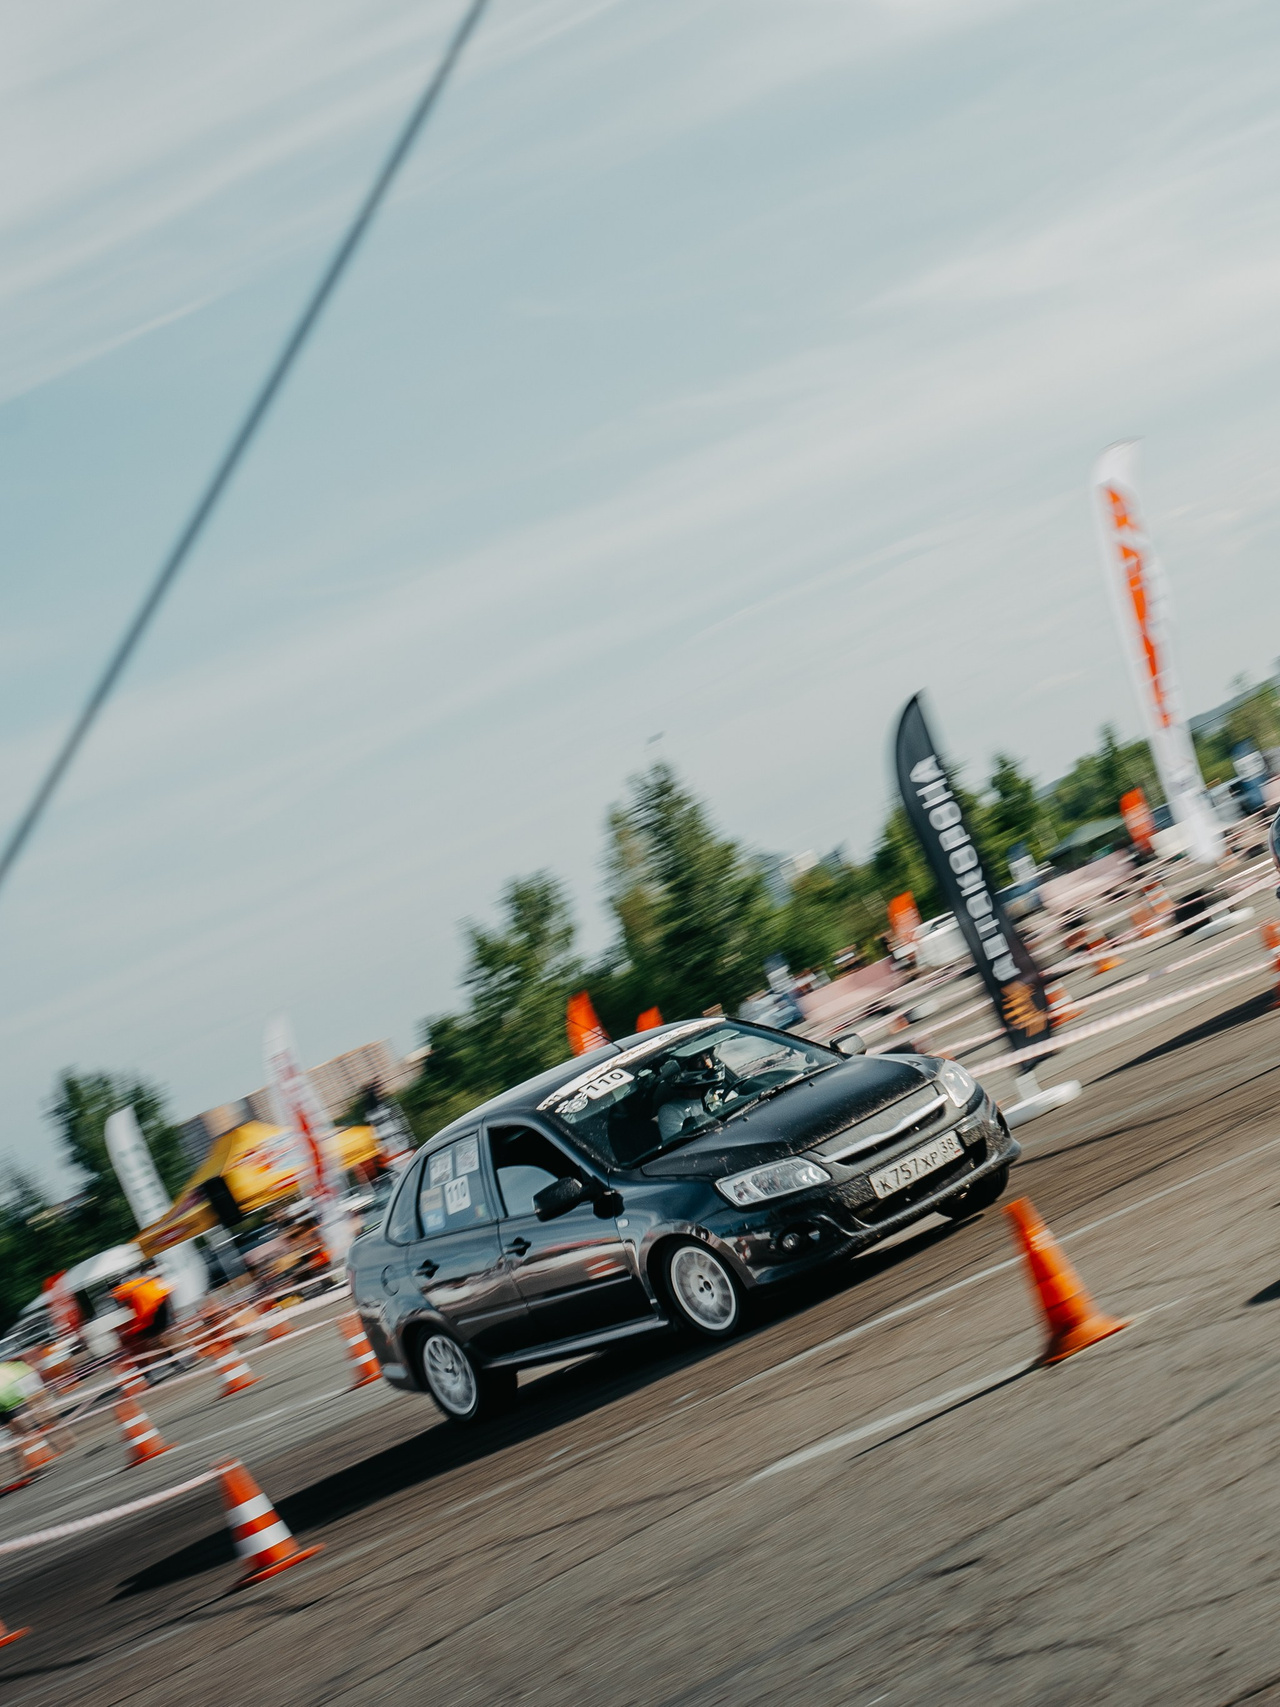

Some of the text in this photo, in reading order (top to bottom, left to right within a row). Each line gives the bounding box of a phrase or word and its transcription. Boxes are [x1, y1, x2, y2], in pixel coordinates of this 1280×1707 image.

[909, 754, 1021, 981] АВТОКОРОНА
[586, 1071, 624, 1091] 110
[939, 1138, 955, 1154] 38
[447, 1180, 467, 1204] 110
